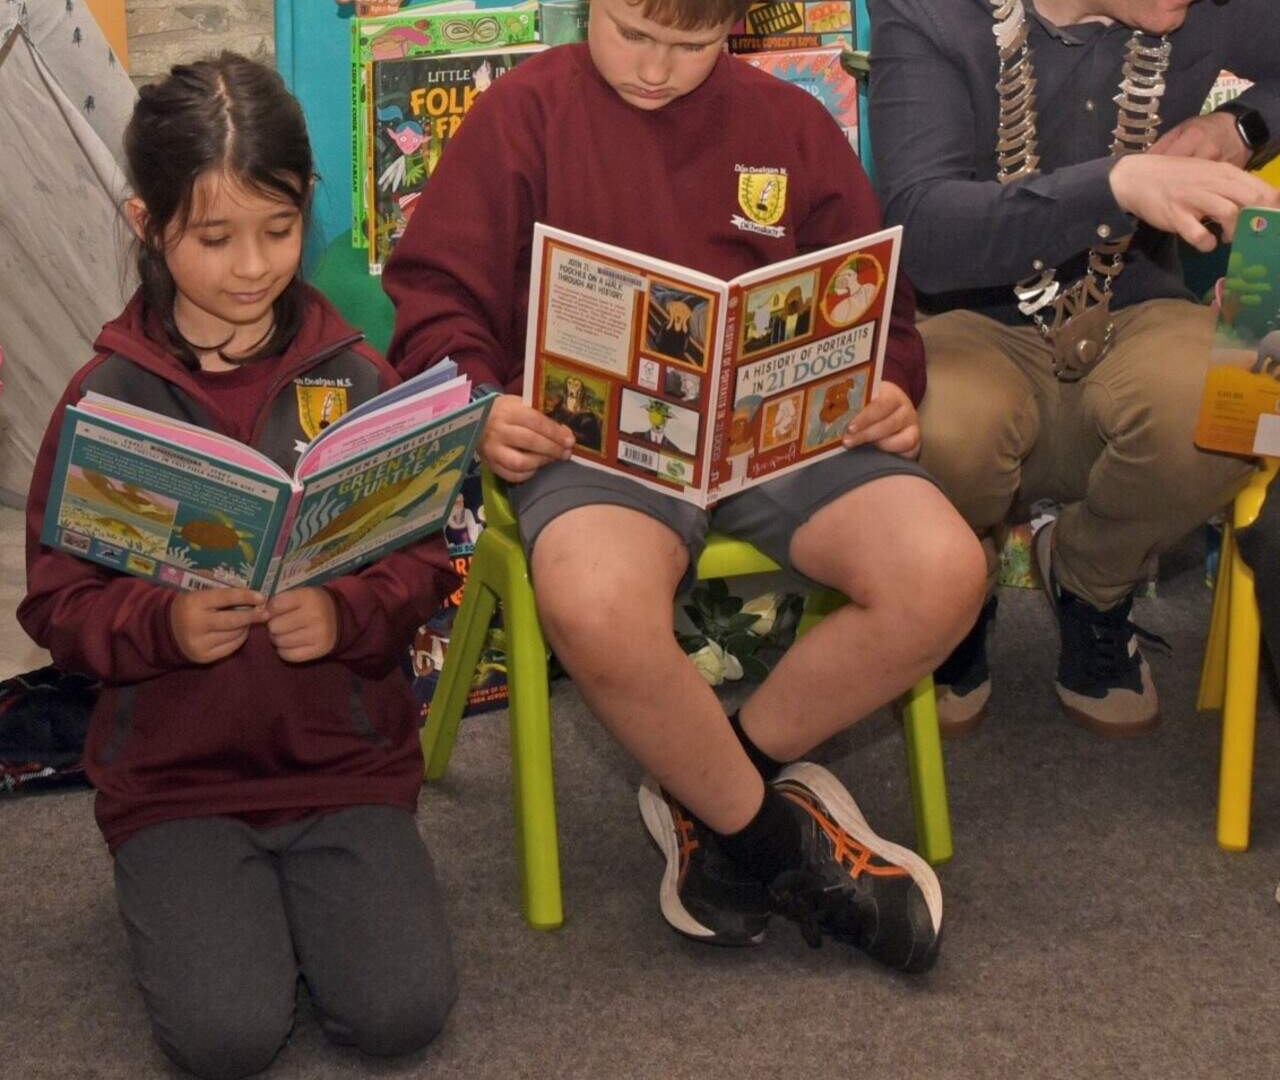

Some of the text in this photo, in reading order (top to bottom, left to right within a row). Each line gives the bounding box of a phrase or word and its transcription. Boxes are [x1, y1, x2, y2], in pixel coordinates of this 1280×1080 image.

[427, 69, 471, 83] LITTLE
[743, 327, 870, 381] A HISTORY OF PORTRAITS
[752, 344, 857, 394] IN 21 DOGS
[338, 439, 441, 495] GREEN SEA
[353, 461, 425, 503] TURTLE
